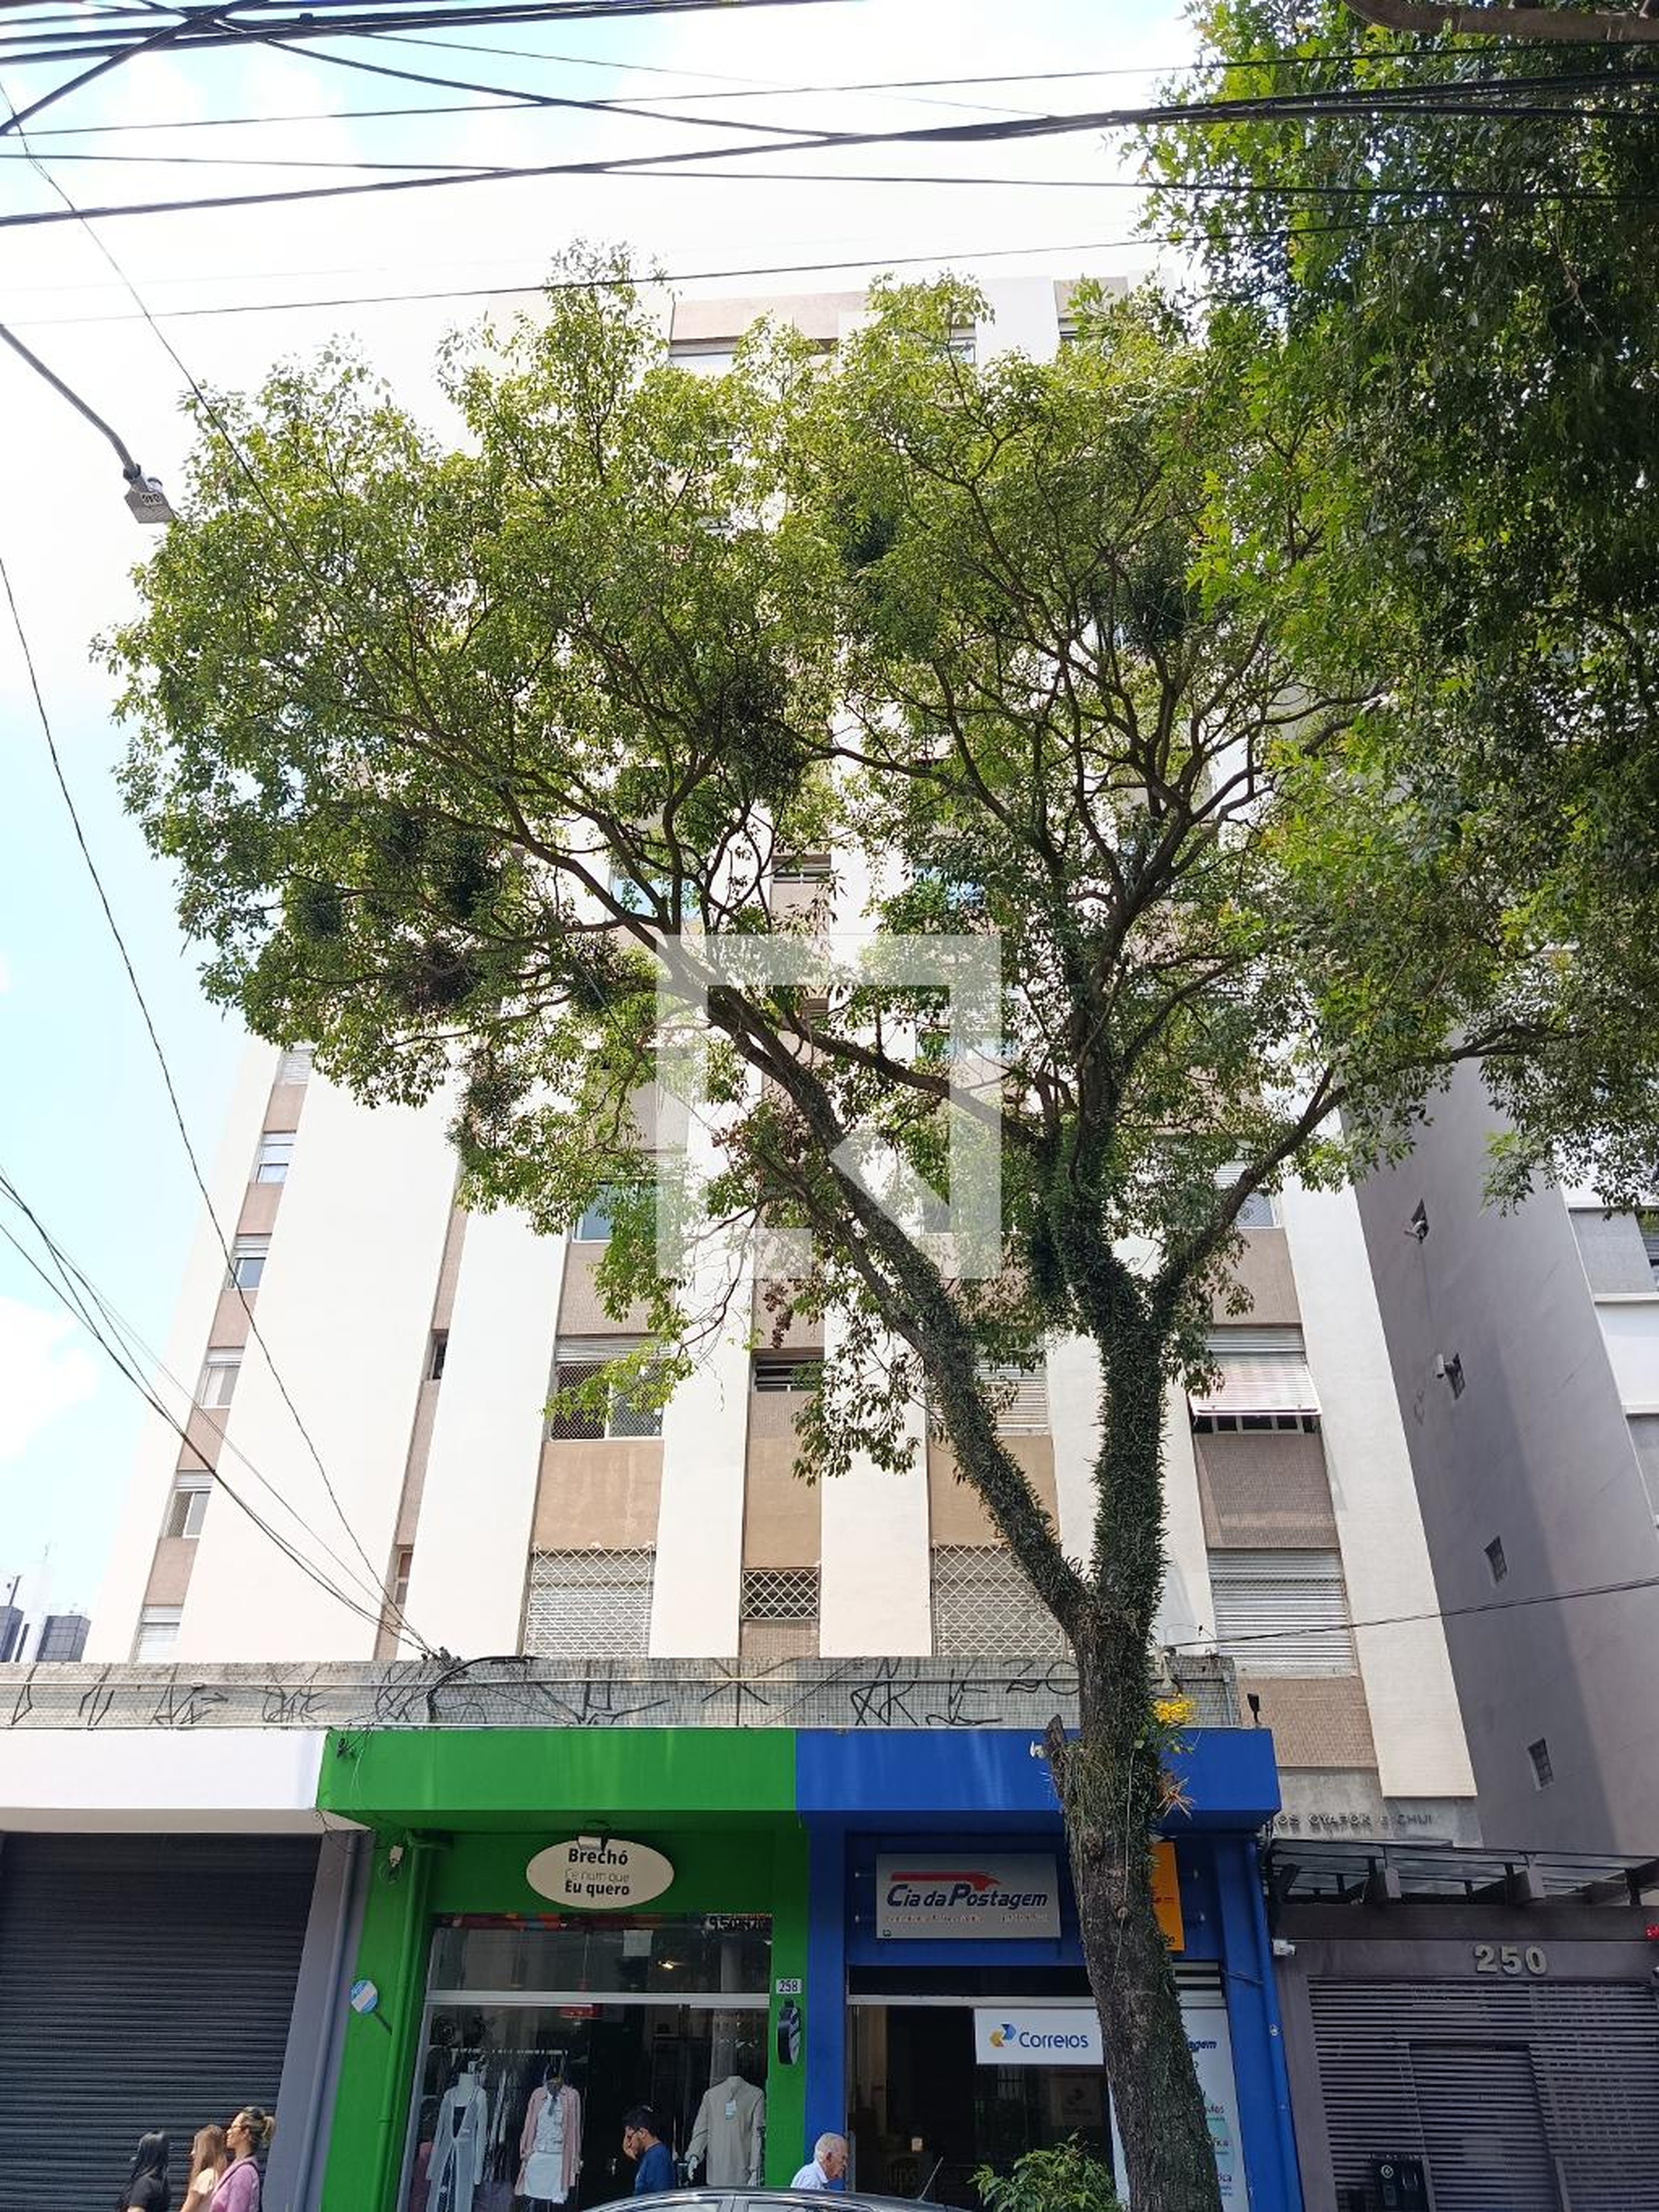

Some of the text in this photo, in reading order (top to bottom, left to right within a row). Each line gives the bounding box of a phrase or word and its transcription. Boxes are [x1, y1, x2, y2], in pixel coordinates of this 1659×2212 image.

[568, 1849, 629, 1865] Brechó
[565, 1880, 629, 1897] Eu quero
[887, 1883, 1048, 1910] Cia da Postagem
[1475, 1945, 1547, 1975] 250
[779, 1980, 798, 1992] 258
[1019, 2031, 1089, 2048] Correios
